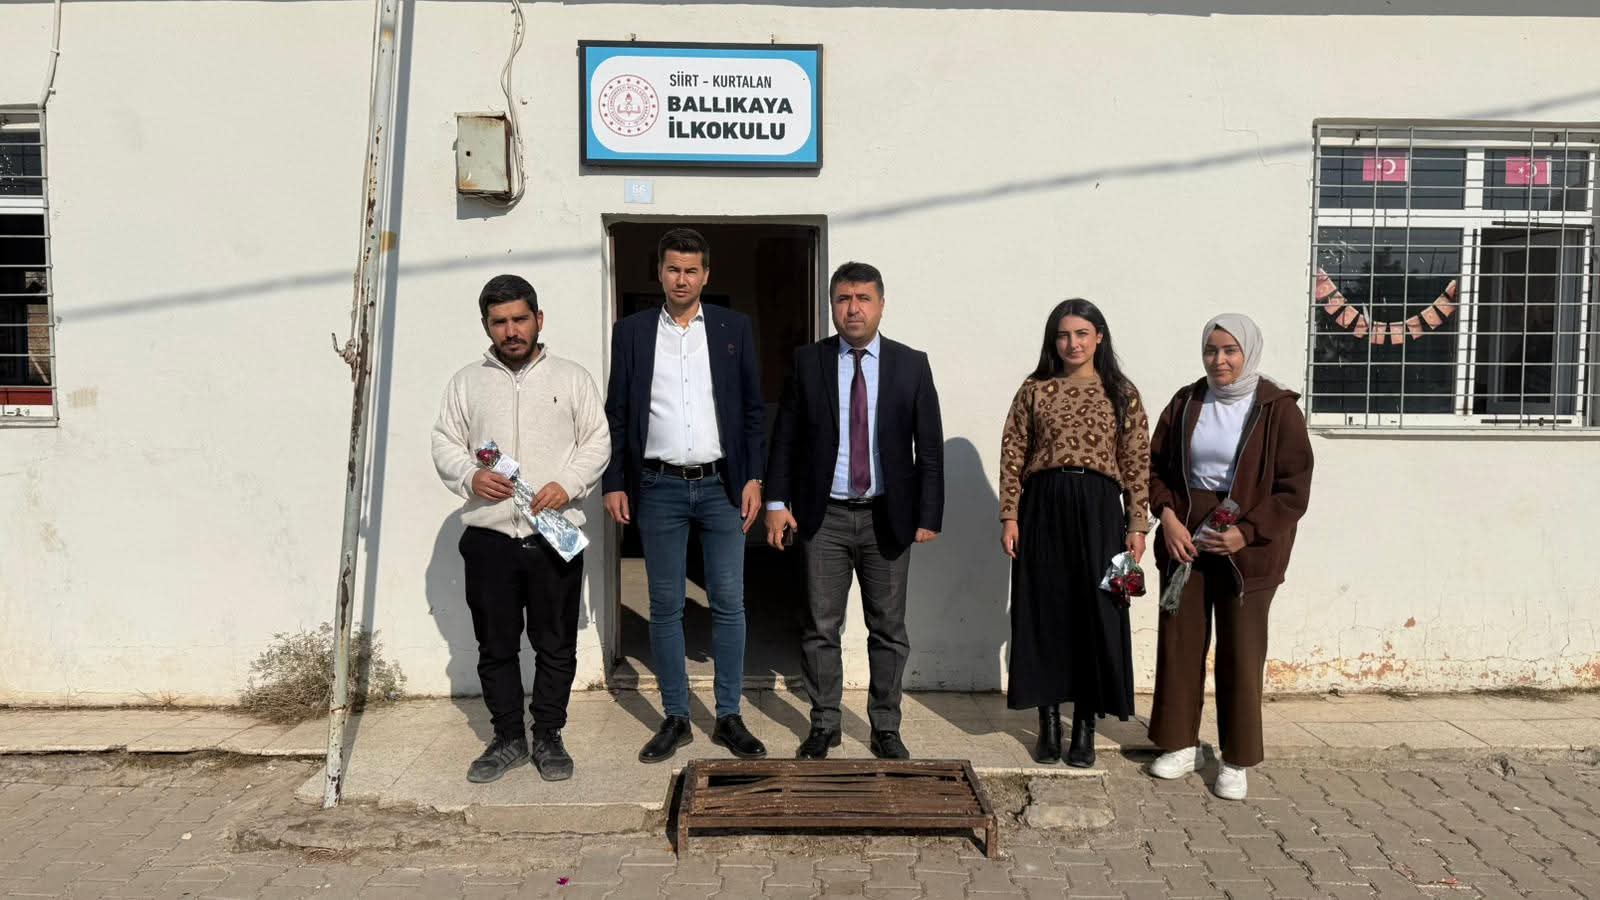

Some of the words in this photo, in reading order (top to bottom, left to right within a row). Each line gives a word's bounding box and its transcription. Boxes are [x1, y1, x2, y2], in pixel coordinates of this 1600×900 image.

[669, 70, 699, 87] SİİRT
[712, 74, 772, 89] KURTALAN
[667, 95, 793, 114] BALLIKAYA
[668, 116, 786, 140] İLKOKULU
